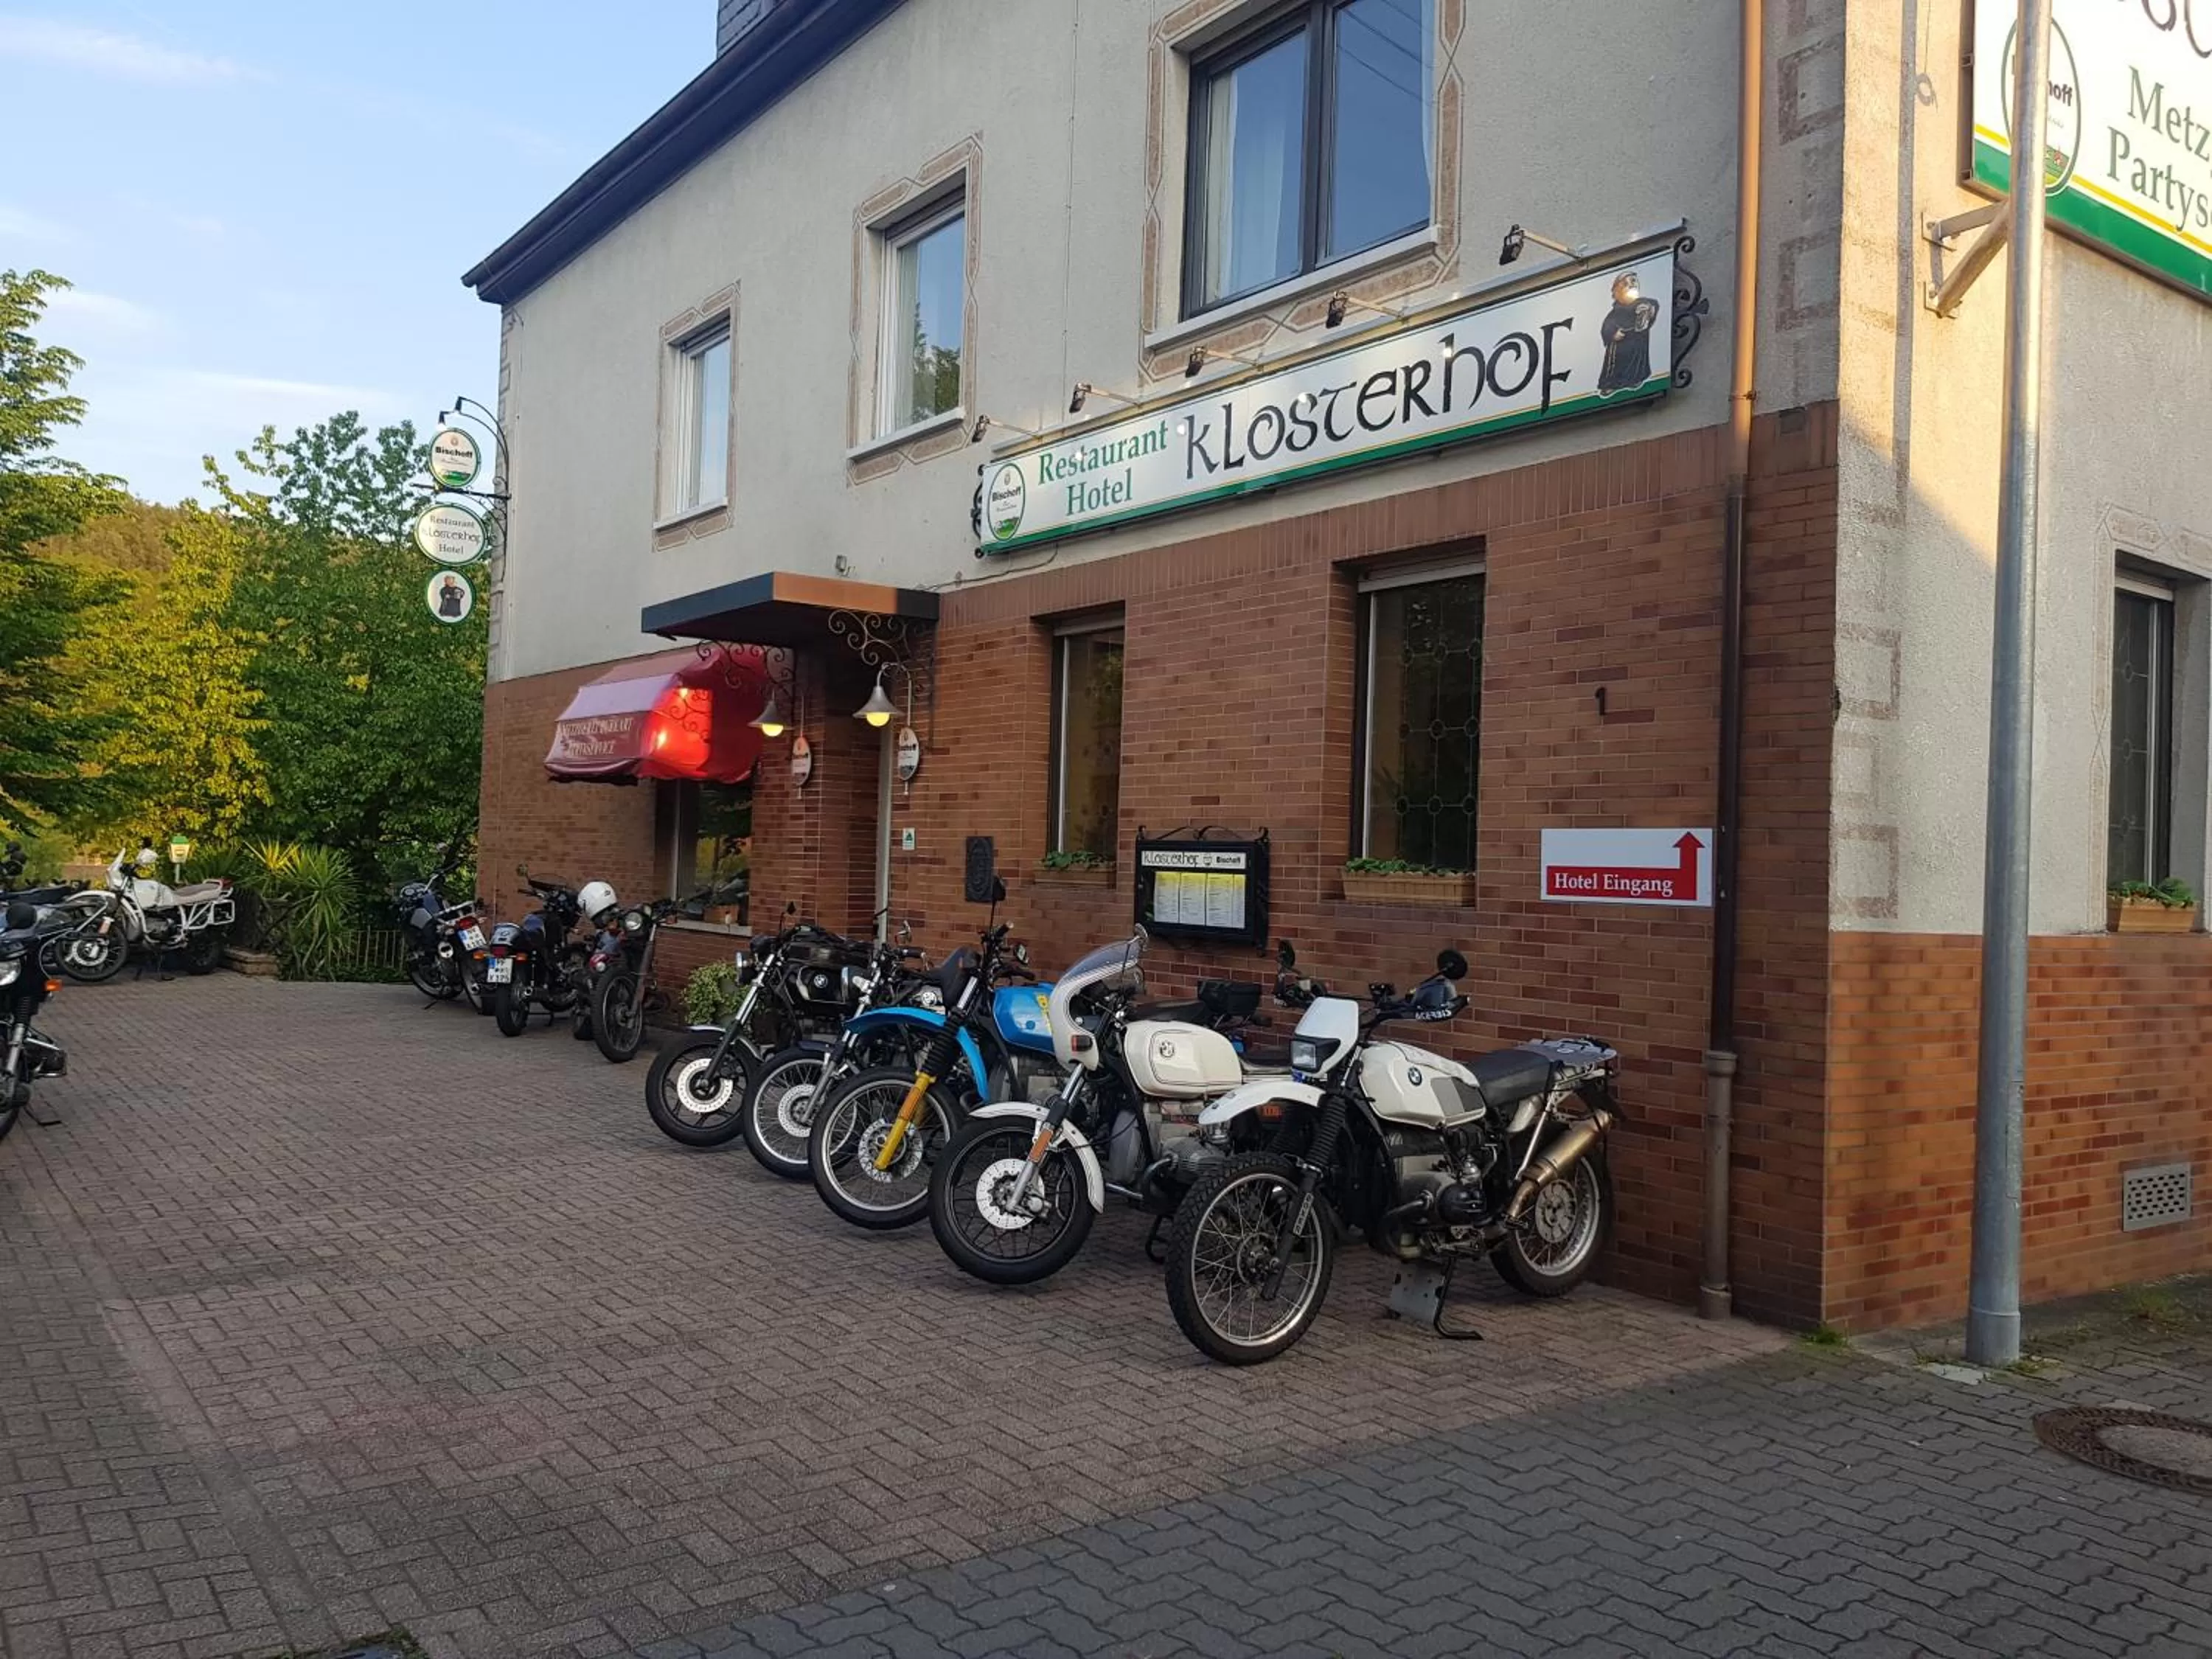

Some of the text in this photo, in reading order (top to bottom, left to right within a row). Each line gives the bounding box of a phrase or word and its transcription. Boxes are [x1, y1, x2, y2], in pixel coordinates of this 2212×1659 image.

[2127, 65, 2212, 163] Metz
[2107, 125, 2212, 232] Partys
[435, 445, 473, 459] Bischoff
[1038, 420, 1169, 486] Restaurant
[1066, 467, 1133, 517] Hotel
[430, 515, 475, 528] Restaurant
[438, 543, 465, 554] Hotel
[1554, 872, 1674, 897] Hotel Eingang
